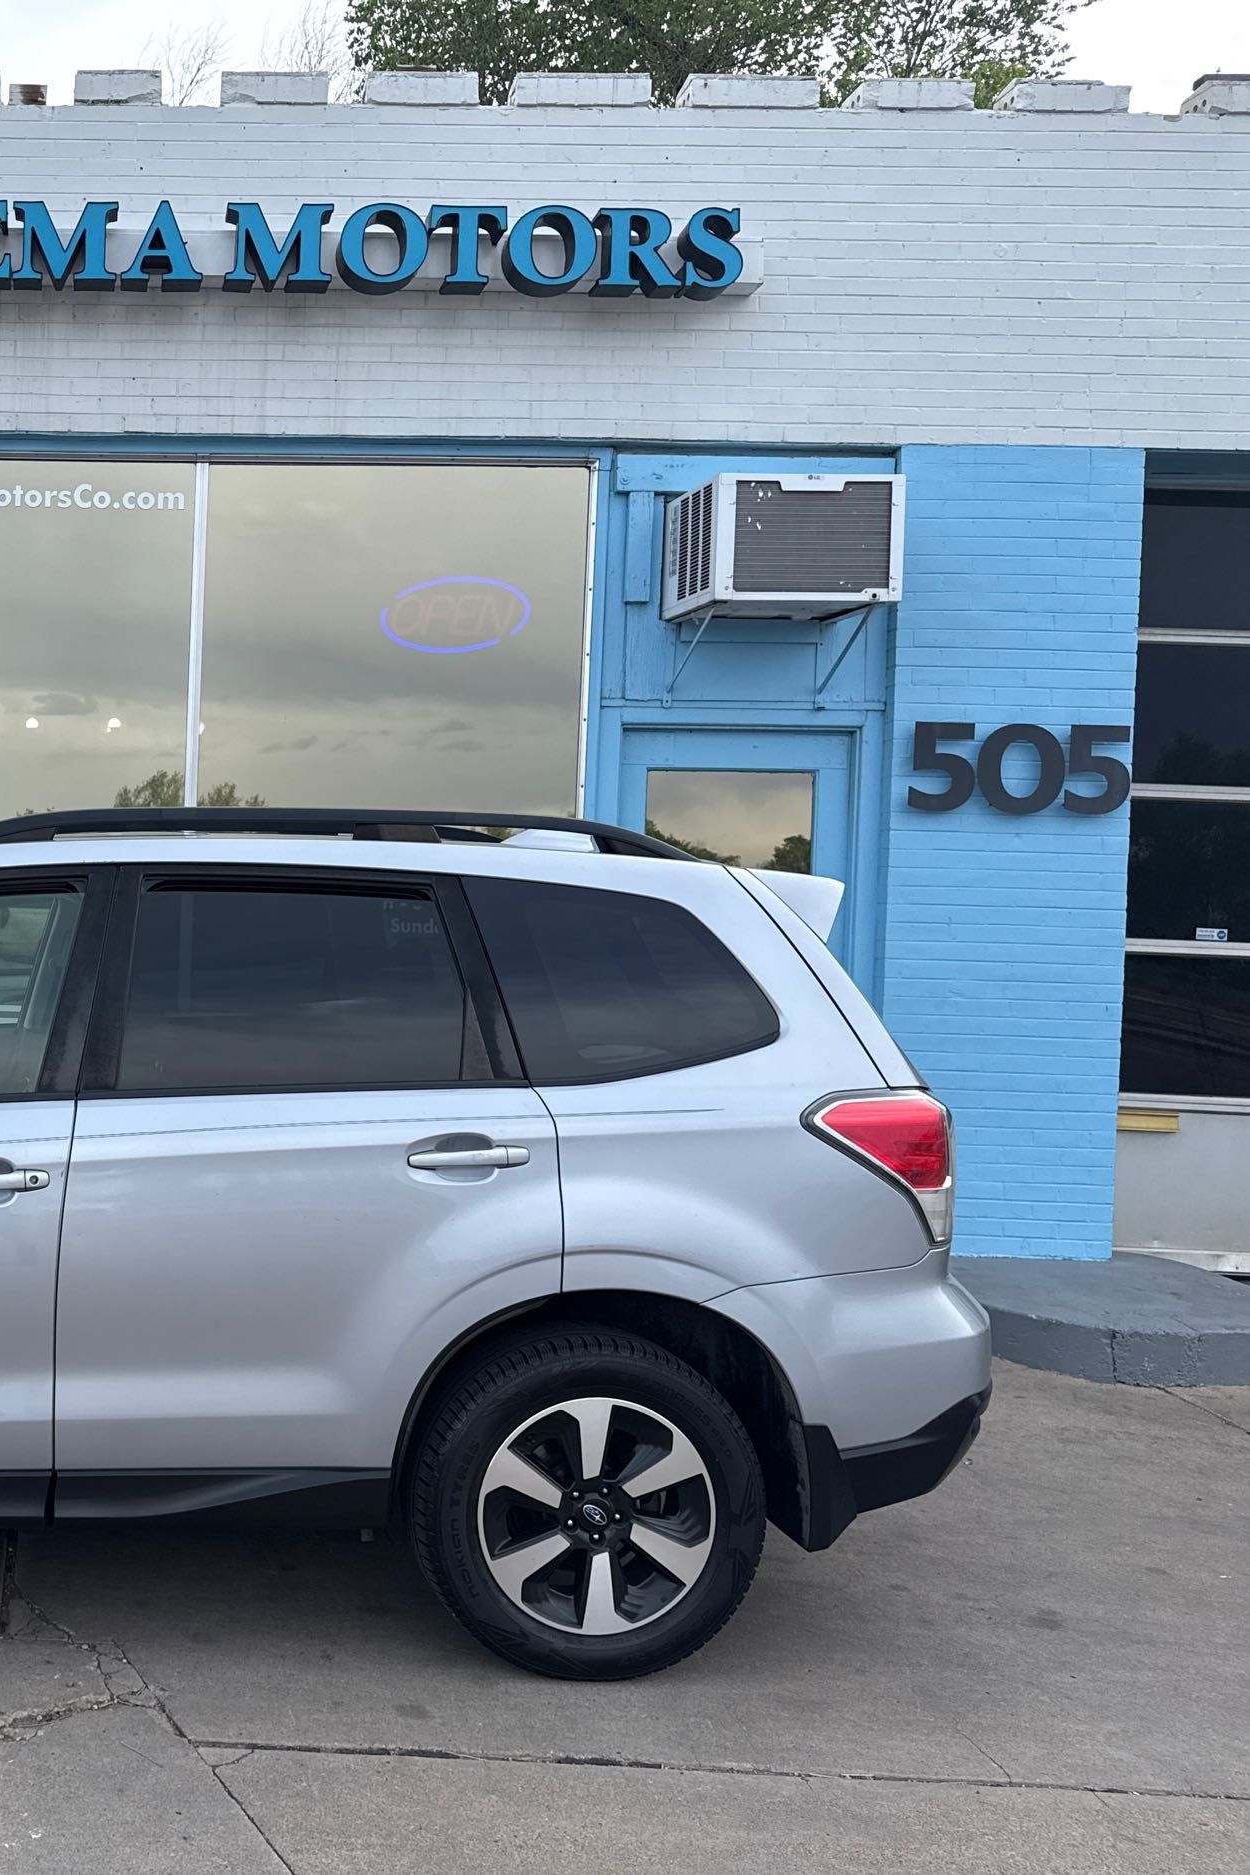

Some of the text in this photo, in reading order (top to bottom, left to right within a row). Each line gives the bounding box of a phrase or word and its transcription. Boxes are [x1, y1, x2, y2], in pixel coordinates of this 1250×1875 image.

[222, 202, 744, 300] MOTORS
[390, 592, 517, 636] OPEN
[907, 721, 1132, 815] 505
